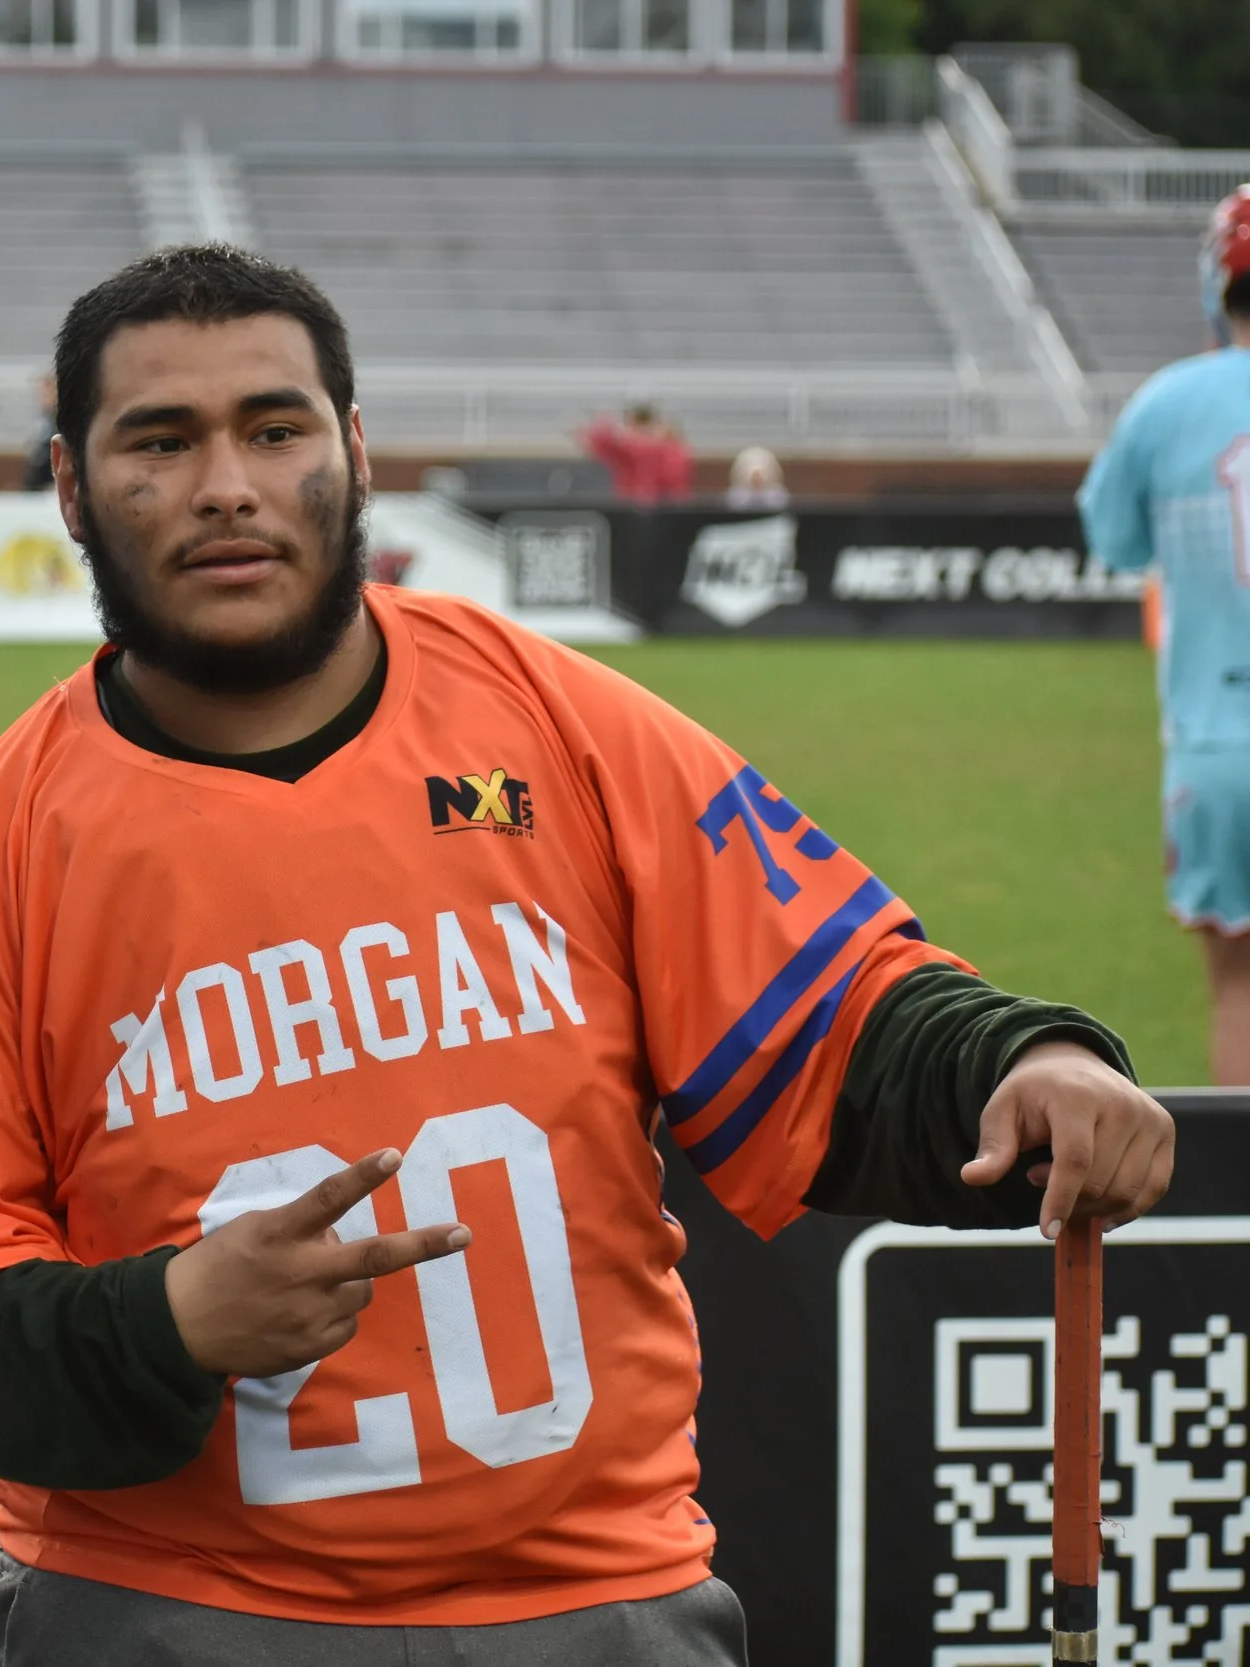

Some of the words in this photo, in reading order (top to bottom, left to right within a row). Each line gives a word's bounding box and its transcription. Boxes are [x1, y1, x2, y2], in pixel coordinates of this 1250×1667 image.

[832, 546, 983, 600] NEXT
[424, 767, 530, 827] NXT
[492, 825, 534, 840] SPORTS
[104, 901, 587, 1131] MORGAN
[196, 1103, 594, 1506] 20
